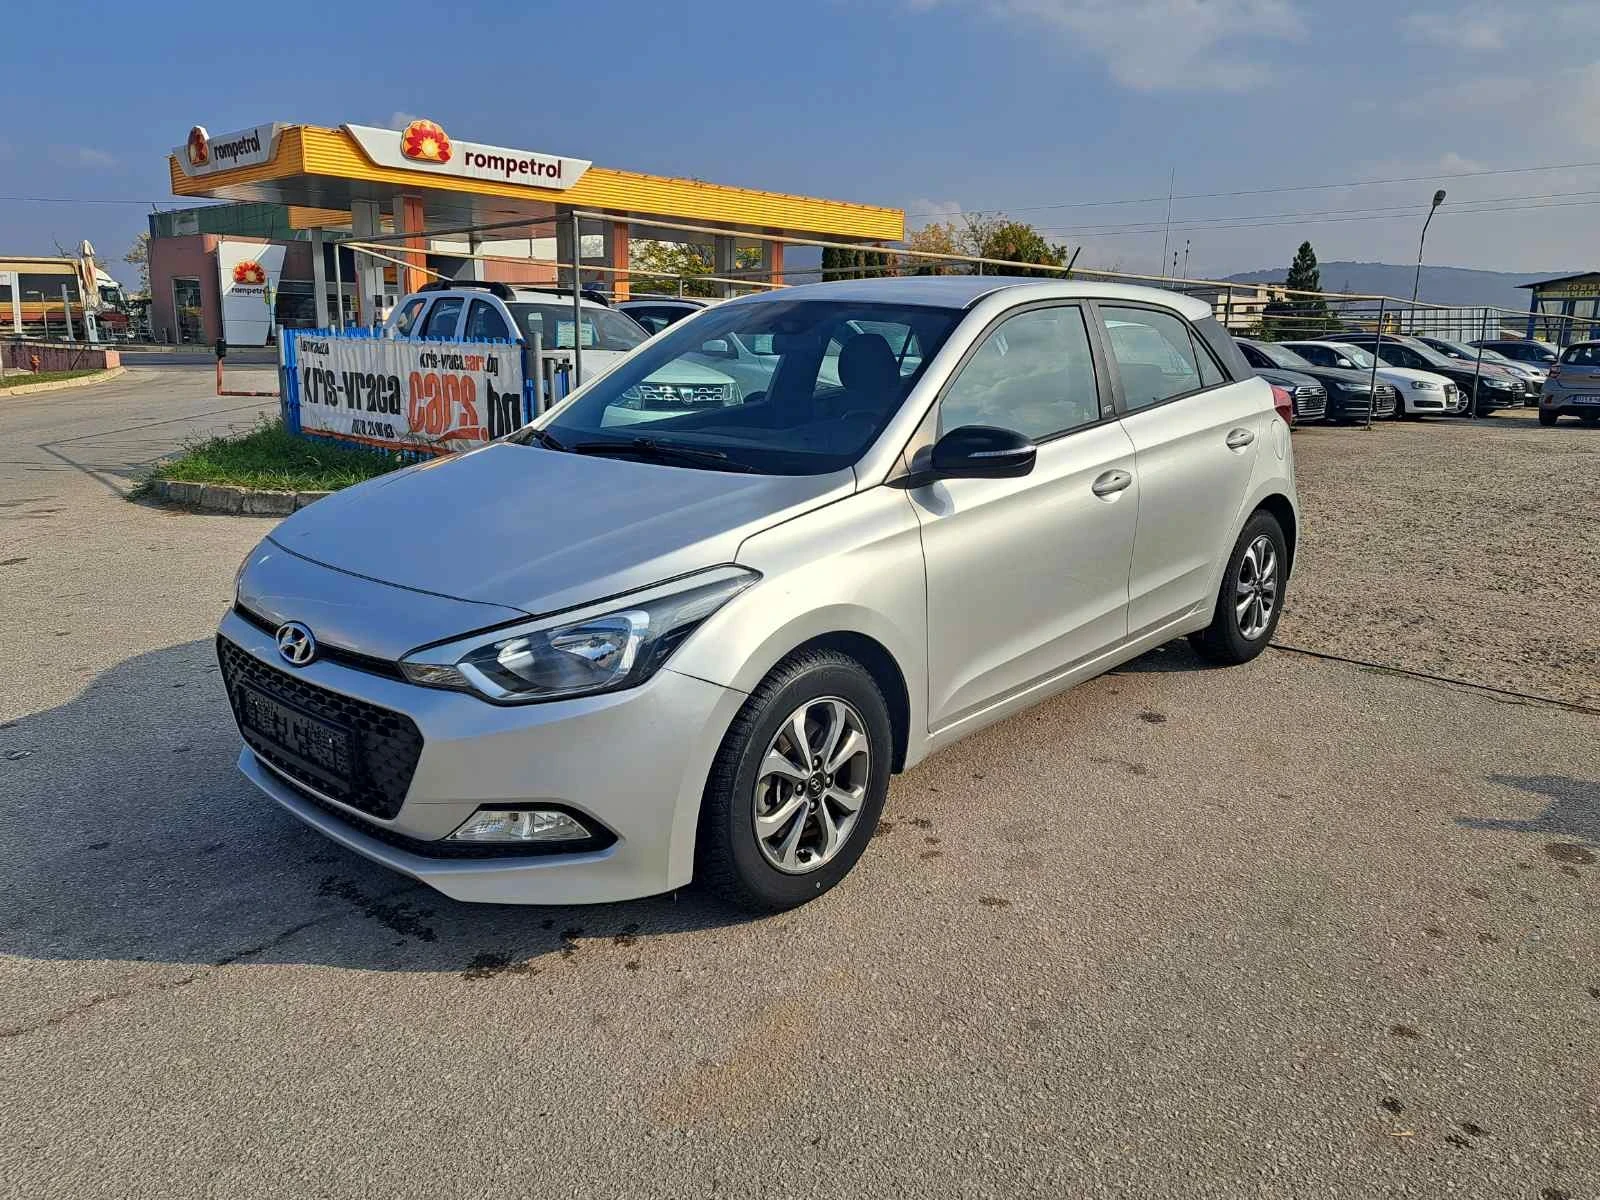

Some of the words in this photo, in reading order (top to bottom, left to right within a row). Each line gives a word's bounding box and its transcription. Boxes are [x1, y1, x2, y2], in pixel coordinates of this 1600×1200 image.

[213, 129, 261, 163] rompetrol
[465, 151, 562, 179] rompetrol
[231, 287, 265, 296] rompetr
